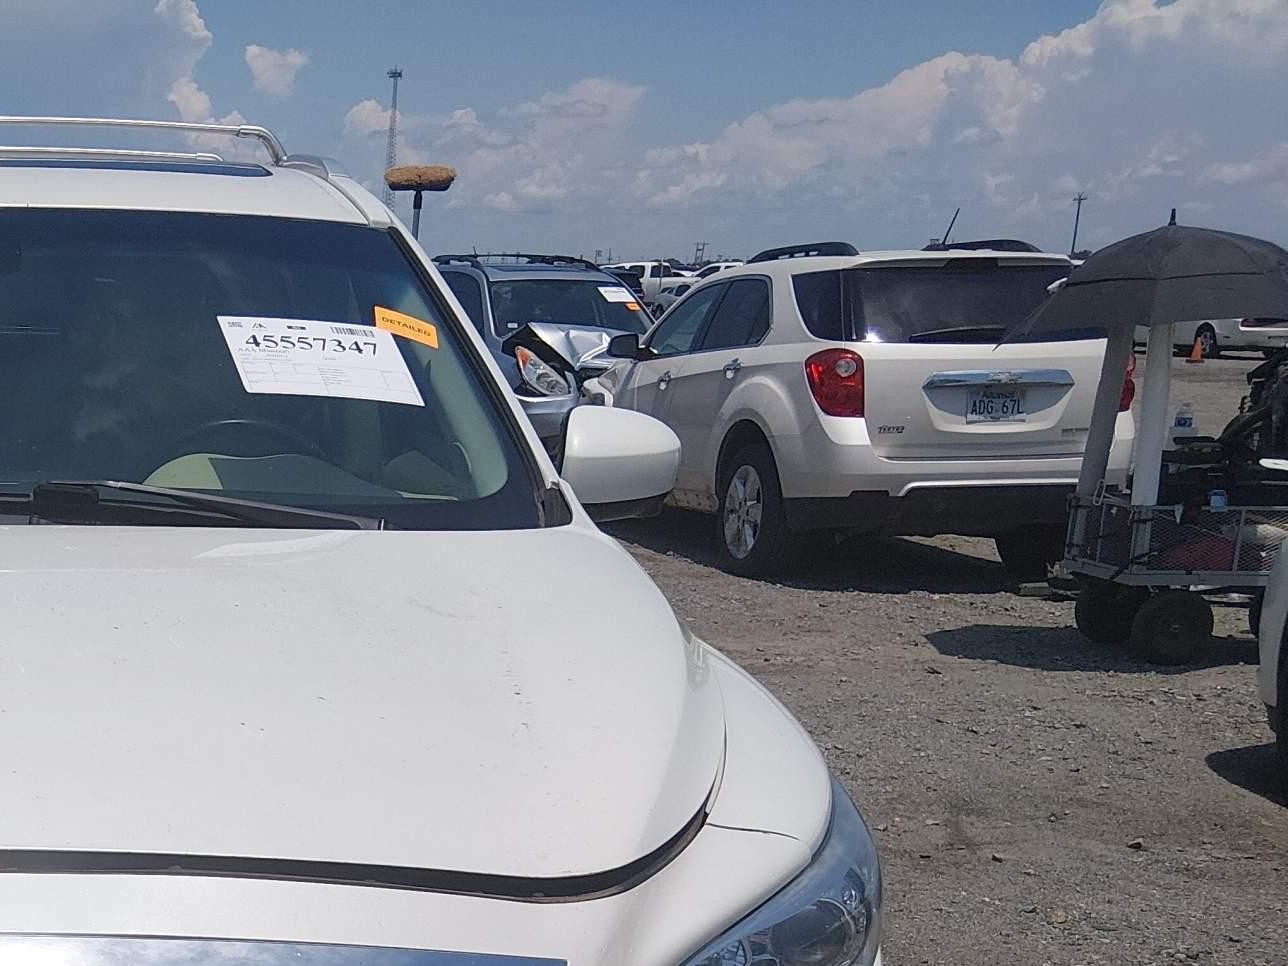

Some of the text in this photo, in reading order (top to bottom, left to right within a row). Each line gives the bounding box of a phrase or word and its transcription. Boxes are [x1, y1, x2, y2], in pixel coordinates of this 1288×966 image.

[381, 315, 431, 337] DETAILED
[245, 333, 377, 357] 45557347
[970, 399, 1025, 415] ADG 67L
